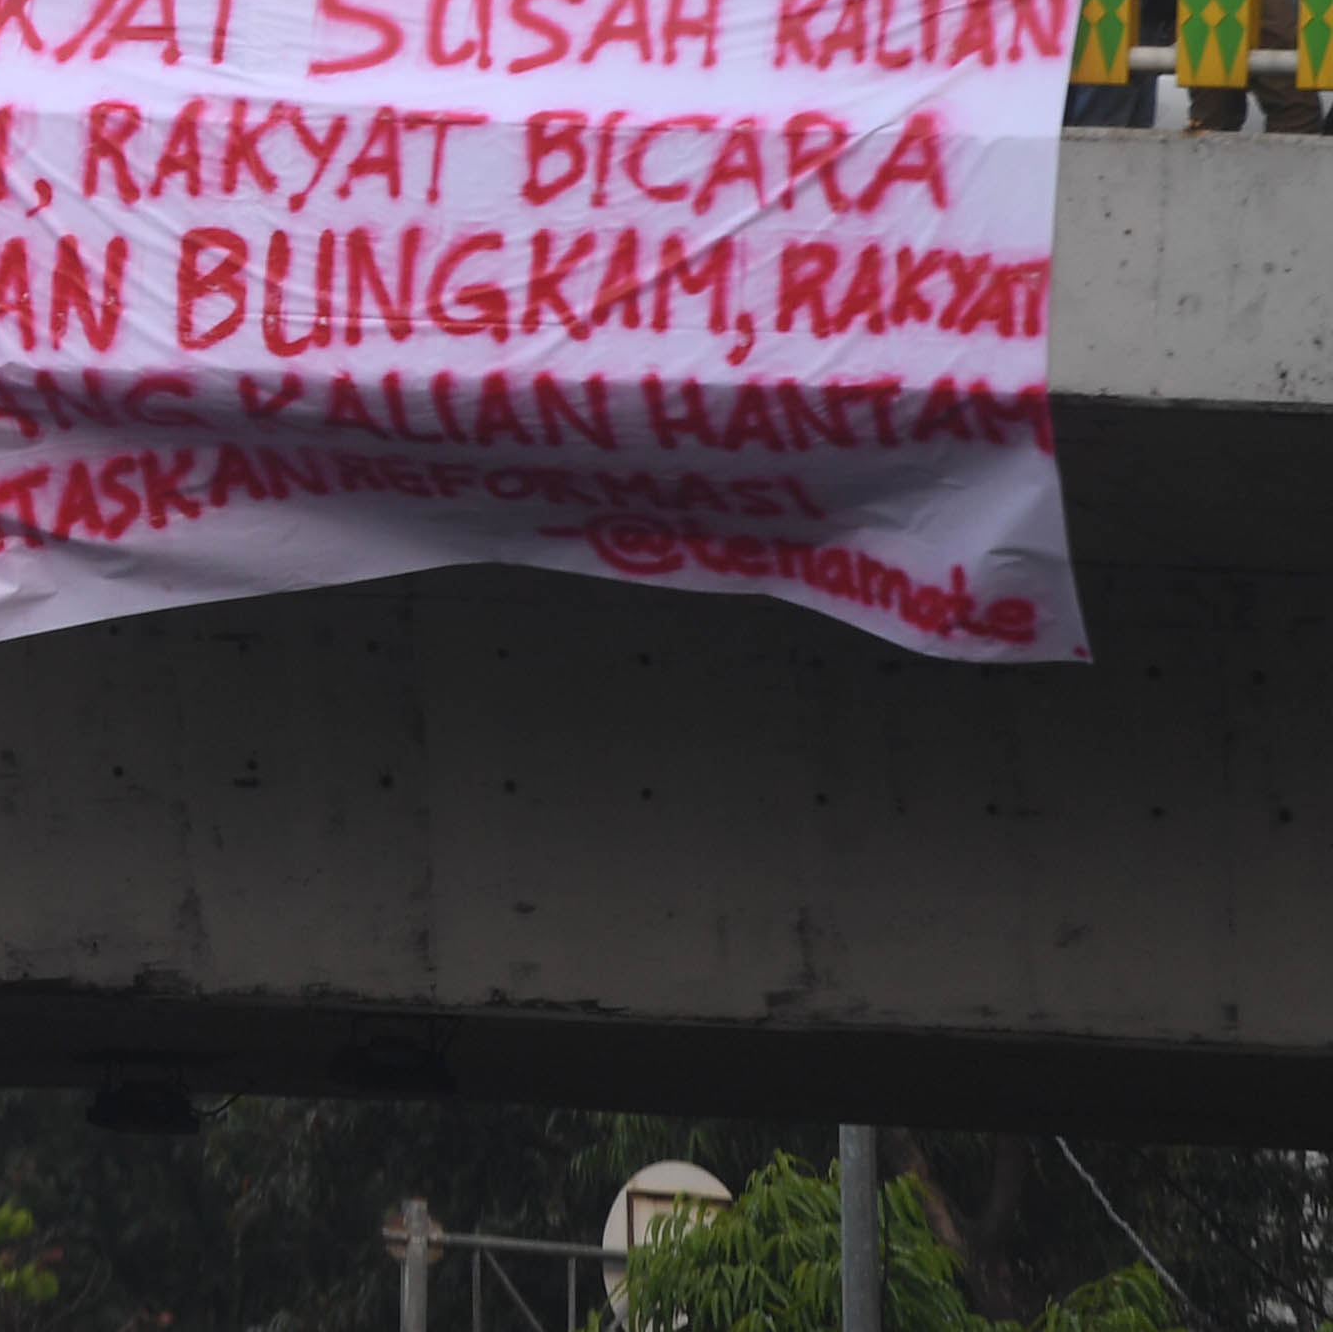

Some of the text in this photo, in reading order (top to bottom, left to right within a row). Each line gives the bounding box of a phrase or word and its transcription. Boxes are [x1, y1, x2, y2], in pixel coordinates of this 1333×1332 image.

[81, 93, 489, 214] RAKYAT
[519, 109, 949, 215] BICARA
[176, 226, 756, 366] BUNGKAM,
[776, 240, 1051, 340] RAKYAT
[640, 370, 1054, 456] HANTAM
